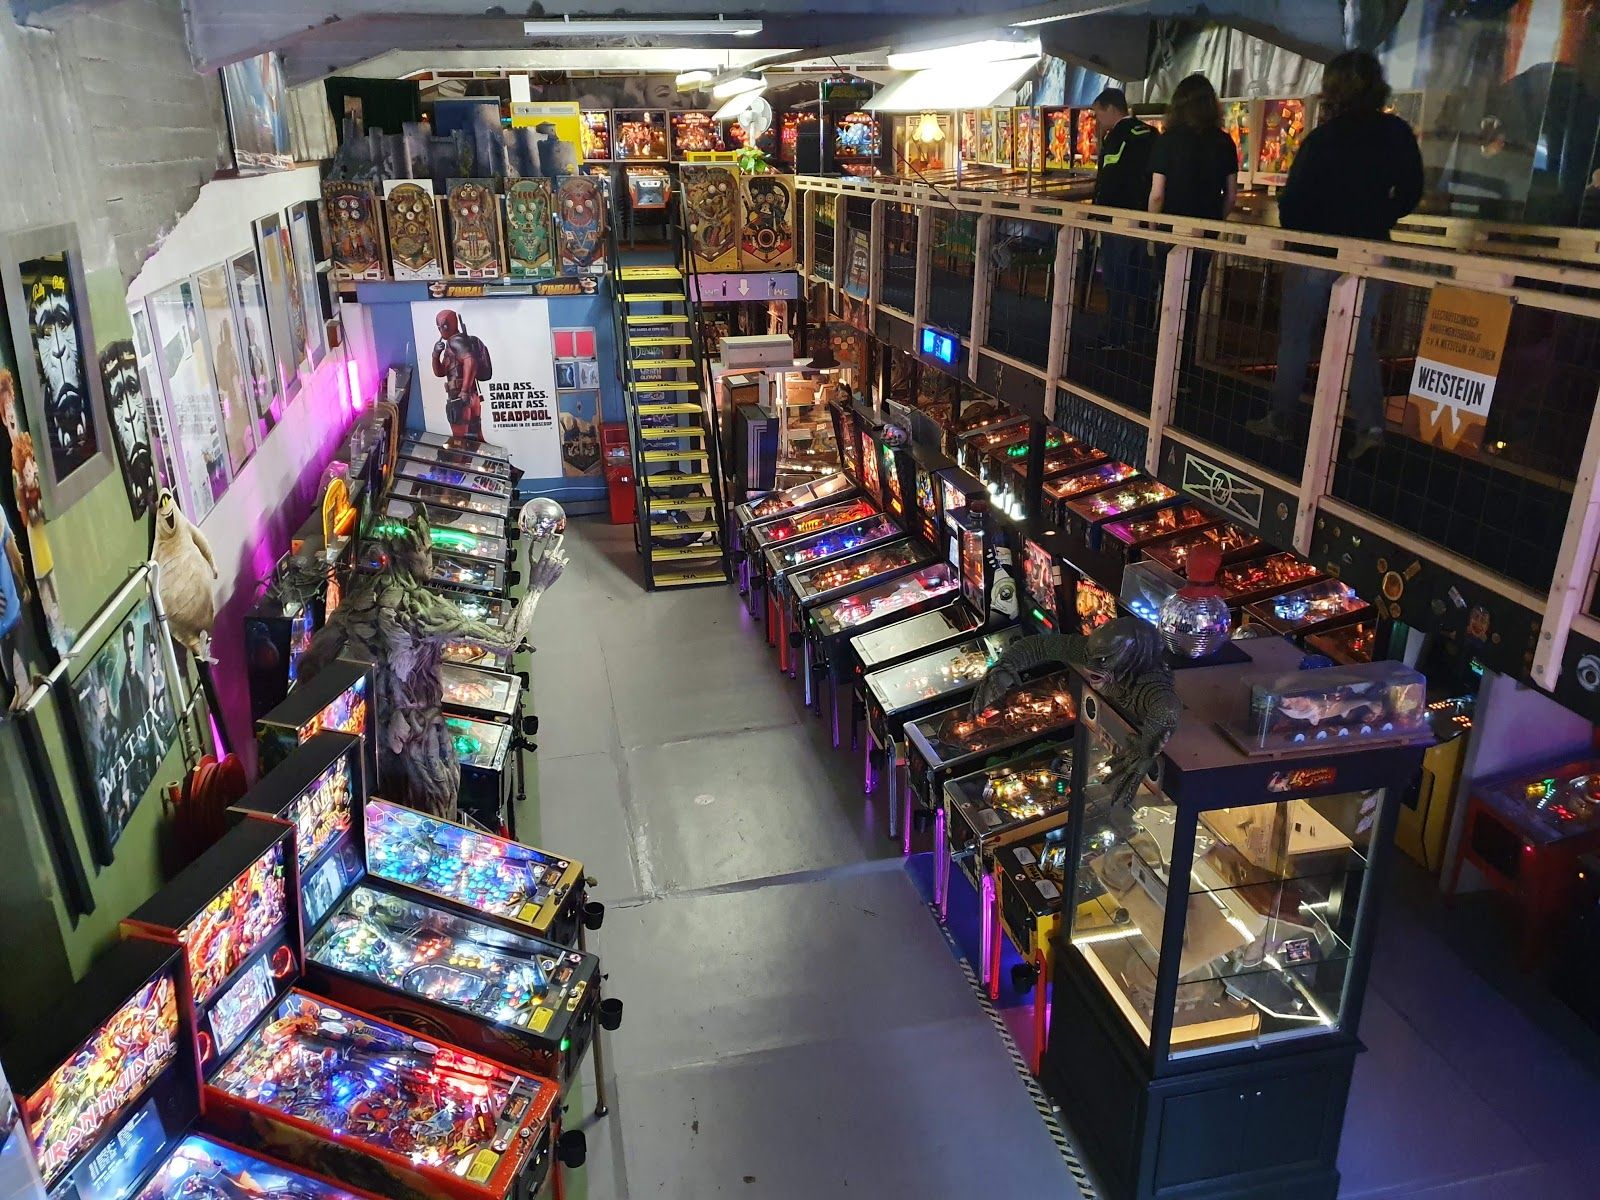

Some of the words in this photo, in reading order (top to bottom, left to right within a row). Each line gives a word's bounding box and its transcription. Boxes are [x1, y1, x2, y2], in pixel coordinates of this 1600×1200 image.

[541, 283, 582, 296] PINBALL
[774, 288, 789, 296] WC
[489, 383, 510, 391] BAD
[513, 382, 535, 391] ASS.
[1418, 365, 1486, 407] WETSTEIJN
[490, 391, 525, 400] SMART
[527, 391, 549, 399] ASS.
[491, 401, 523, 409] GREAT
[526, 400, 548, 409] ASS.
[492, 409, 552, 422] DEADPOOL
[101, 707, 160, 800] MATRIX
[43, 1104, 103, 1171] IRON
[98, 1030, 176, 1115] MAIDEN
